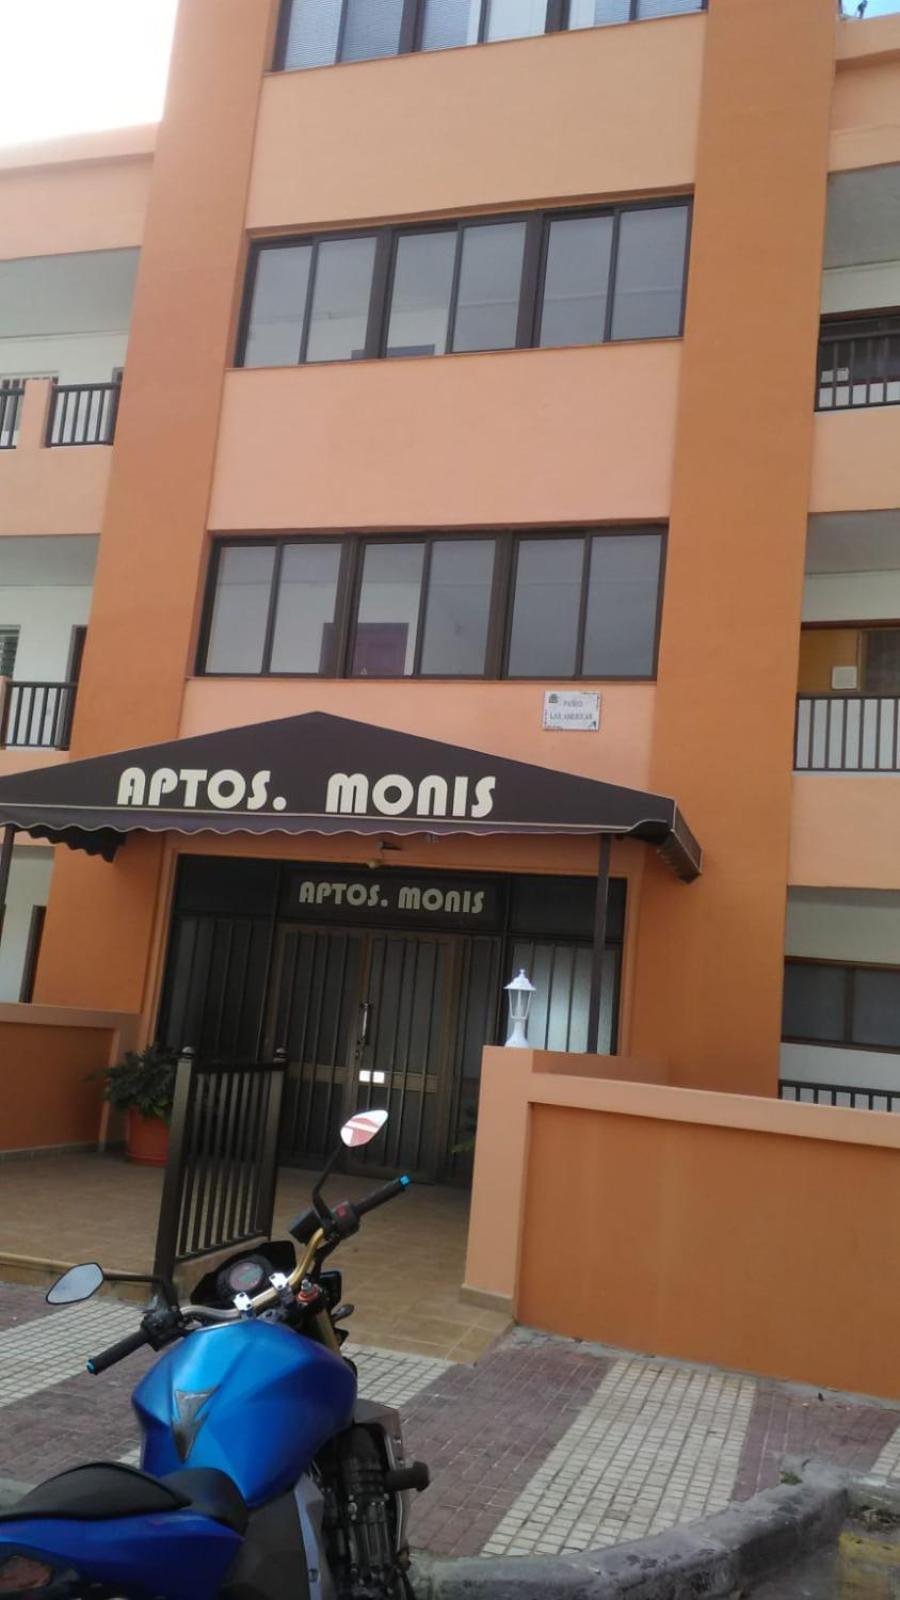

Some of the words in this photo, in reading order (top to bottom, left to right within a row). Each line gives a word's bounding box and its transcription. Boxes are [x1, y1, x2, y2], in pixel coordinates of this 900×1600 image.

[116, 767, 287, 810] APTOS.
[325, 773, 497, 817] MONIS
[299, 881, 388, 907] APTOS.
[397, 887, 484, 913] MONIS
